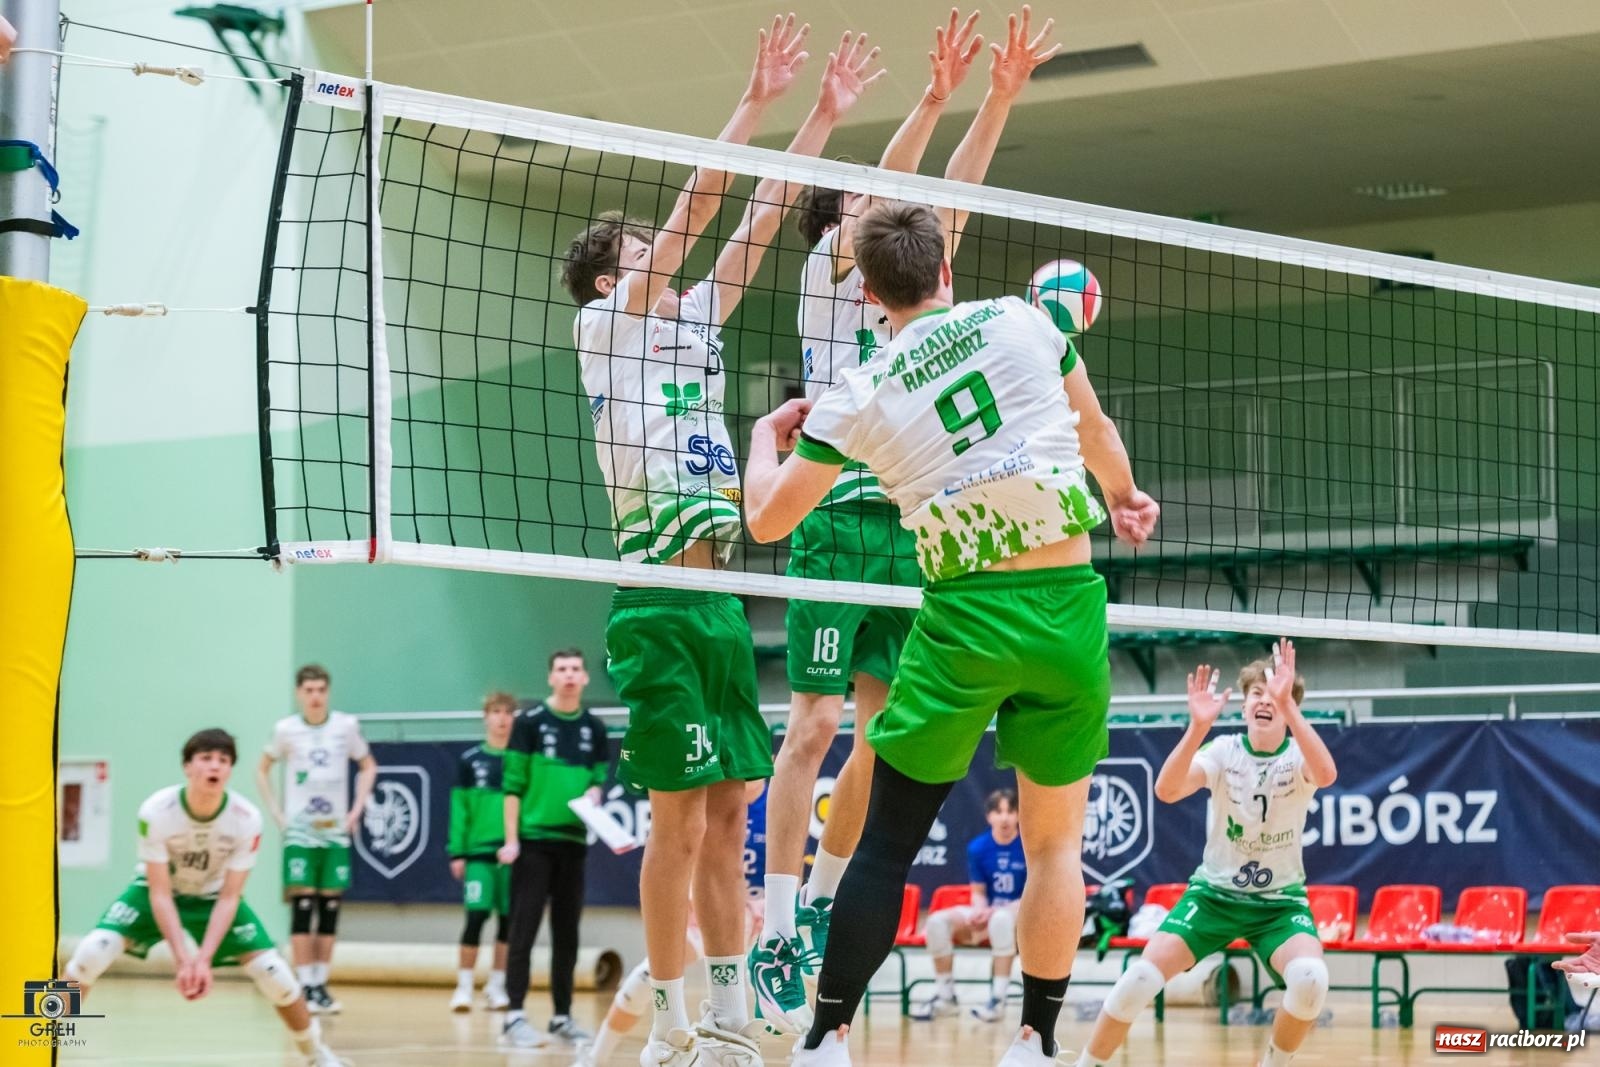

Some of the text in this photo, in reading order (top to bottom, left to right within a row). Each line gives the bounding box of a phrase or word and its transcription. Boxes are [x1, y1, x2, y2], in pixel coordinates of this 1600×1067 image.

[317, 83, 354, 97] netex
[901, 328, 989, 393] RACIBÓRZ
[934, 370, 1003, 456] 9
[296, 548, 332, 559] netex
[813, 627, 839, 663] 18
[806, 667, 841, 675] CUTLINE
[686, 722, 712, 761] 34
[1254, 794, 1267, 823] 7
